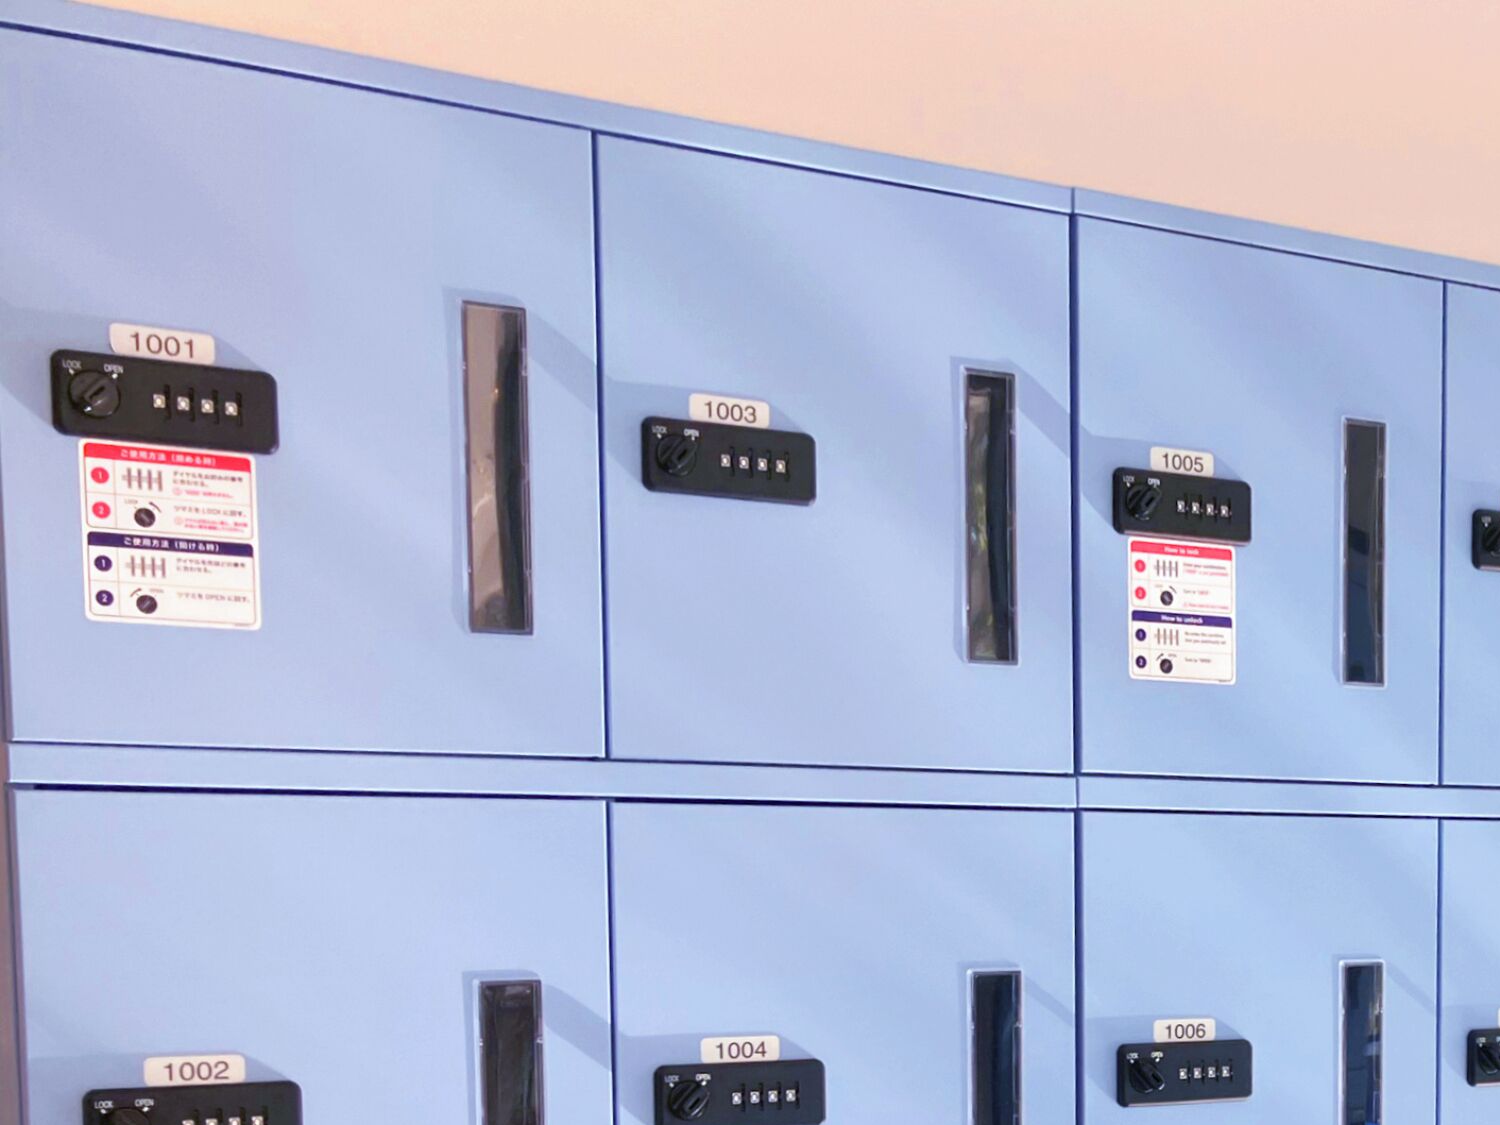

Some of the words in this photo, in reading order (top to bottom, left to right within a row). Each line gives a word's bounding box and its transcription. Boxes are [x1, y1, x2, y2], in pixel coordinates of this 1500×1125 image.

[131, 332, 196, 358] 1001
[62, 360, 81, 369] LOCK
[104, 364, 123, 373] OPEN
[704, 401, 757, 424] 1003
[652, 426, 667, 434] LOCK
[684, 428, 699, 437] OPEN
[1162, 452, 1204, 473] 1005
[1165, 1024, 1206, 1039] 1006
[716, 1041, 767, 1059] 1004
[164, 1061, 230, 1081] 1002
[696, 1073, 711, 1081] OPEN
[95, 1101, 114, 1109] LOCK
[135, 1098, 154, 1107] OPEN
